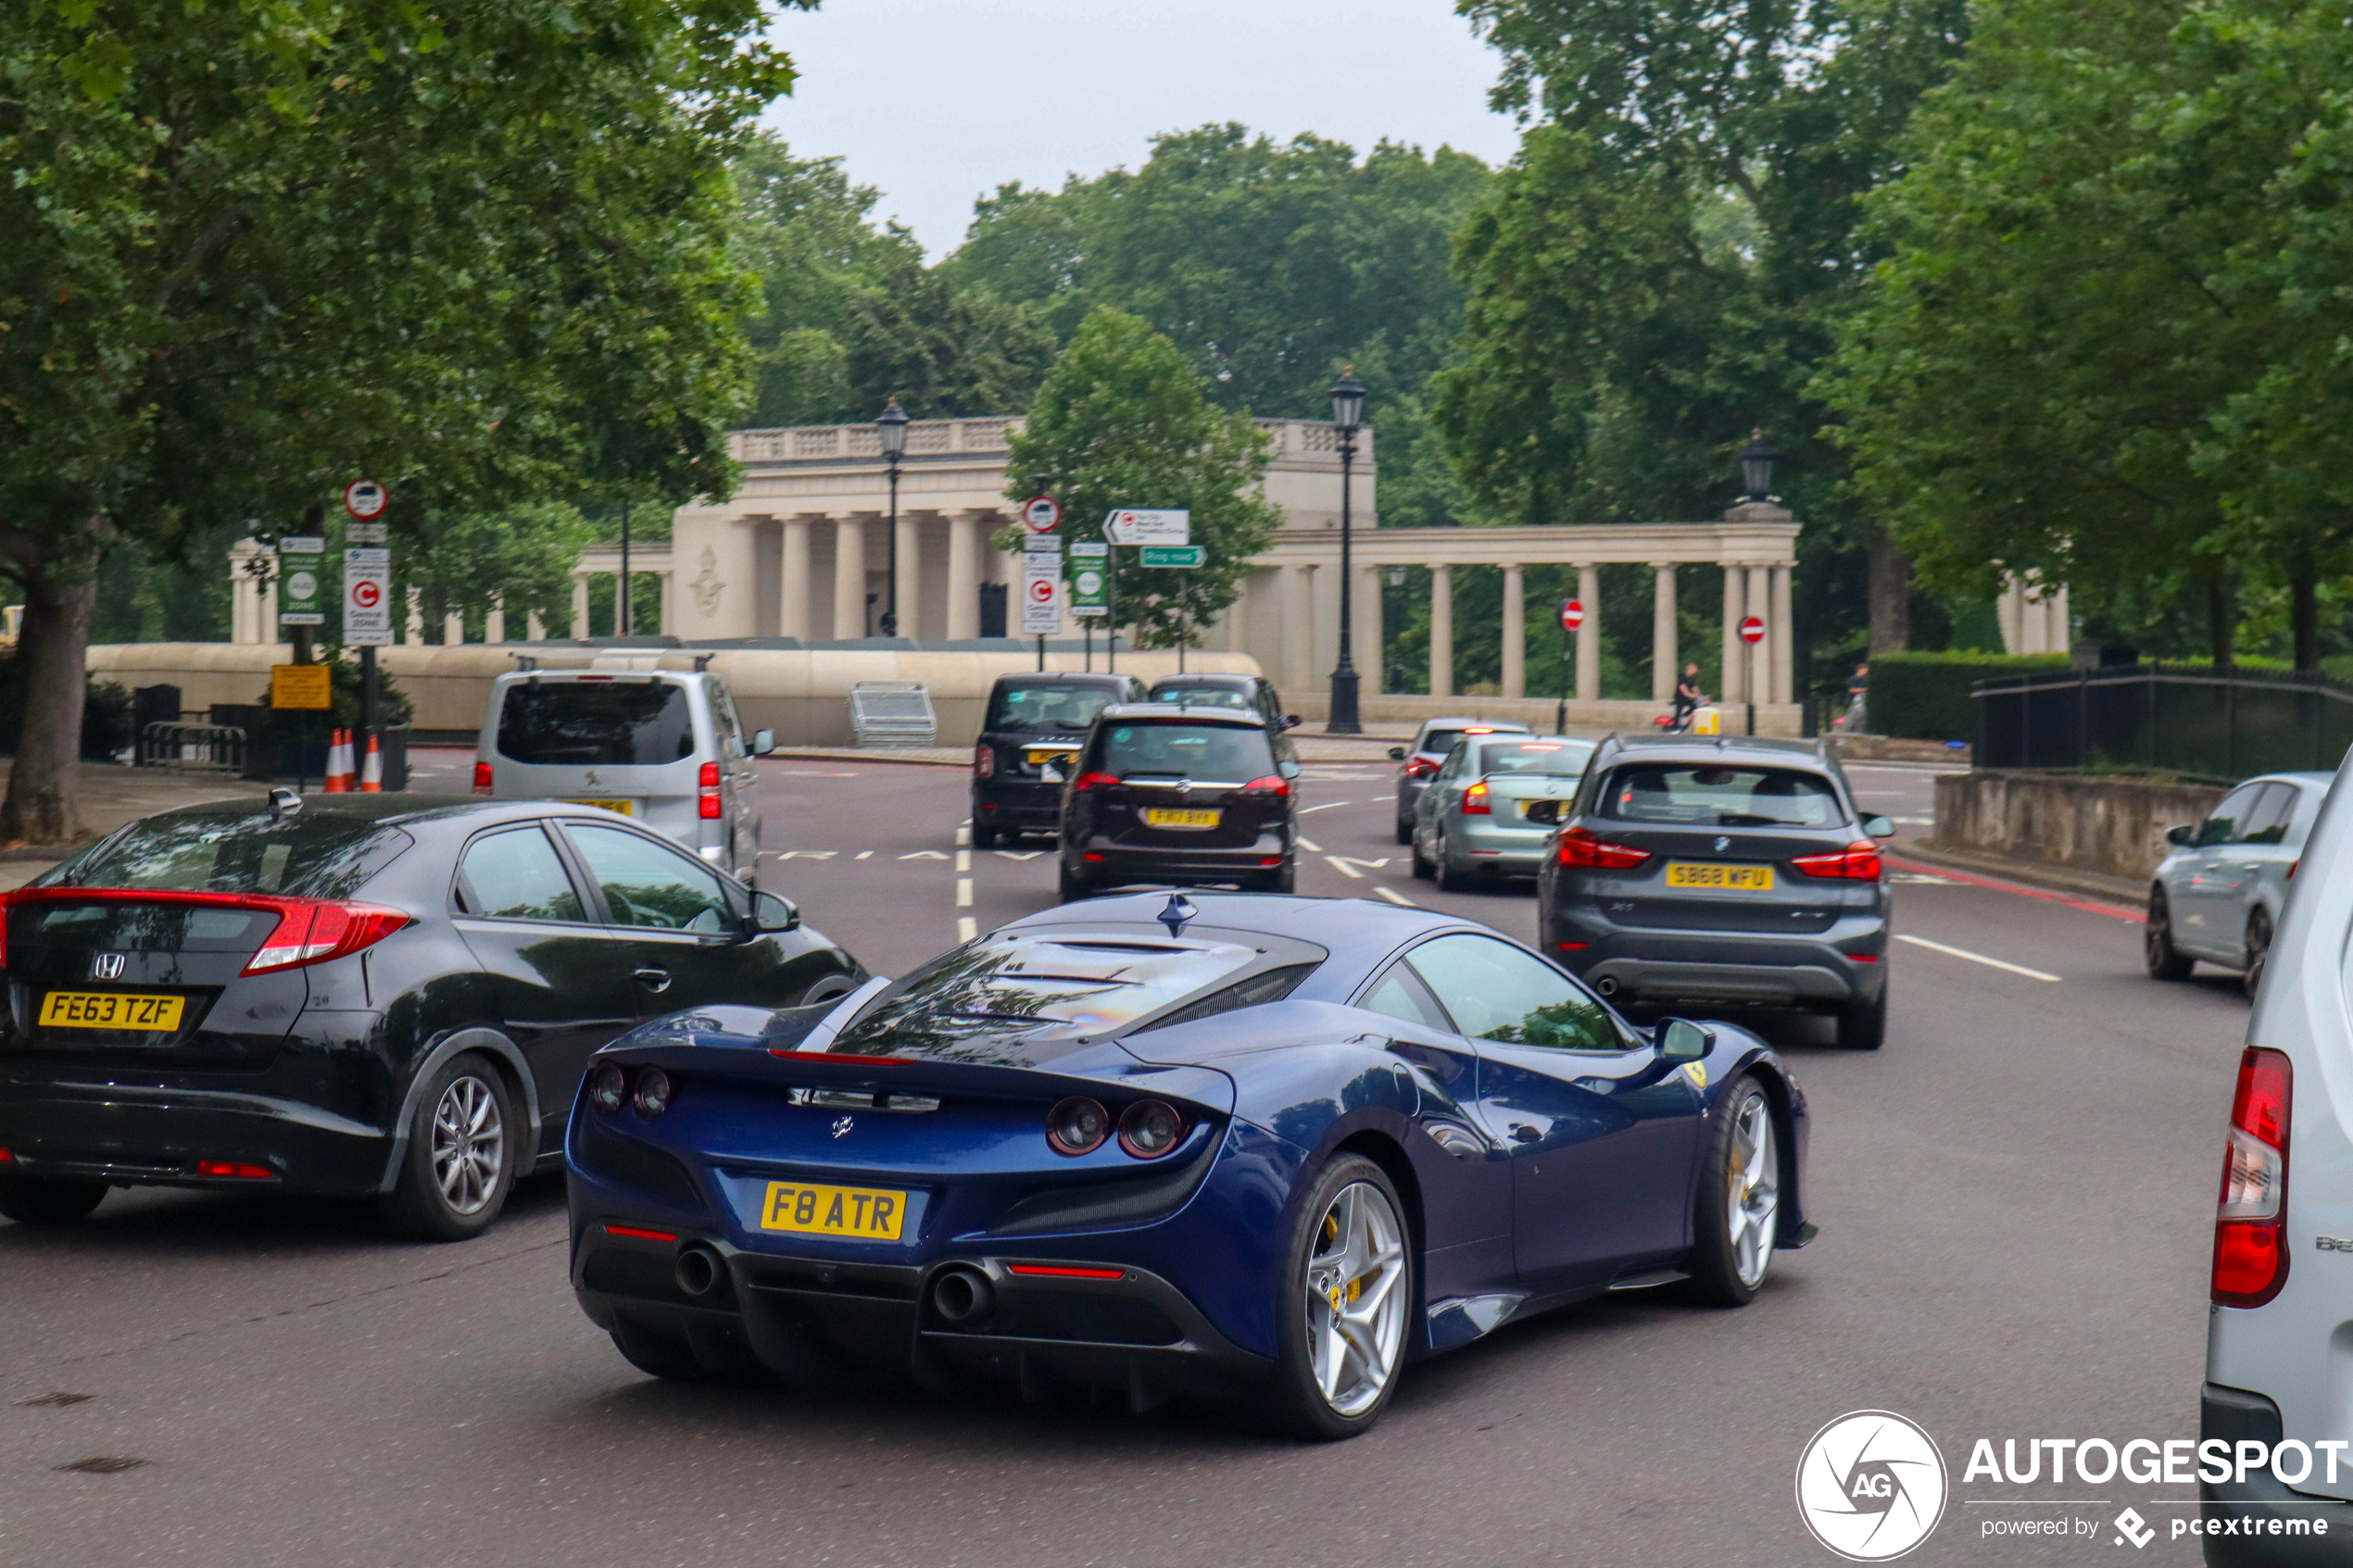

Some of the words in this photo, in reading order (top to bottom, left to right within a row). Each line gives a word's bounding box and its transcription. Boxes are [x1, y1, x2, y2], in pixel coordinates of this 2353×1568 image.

[51, 995, 118, 1022] FE63
[125, 997, 173, 1024] TZF
[771, 1187, 817, 1224] F8
[824, 1192, 895, 1232] ATR
